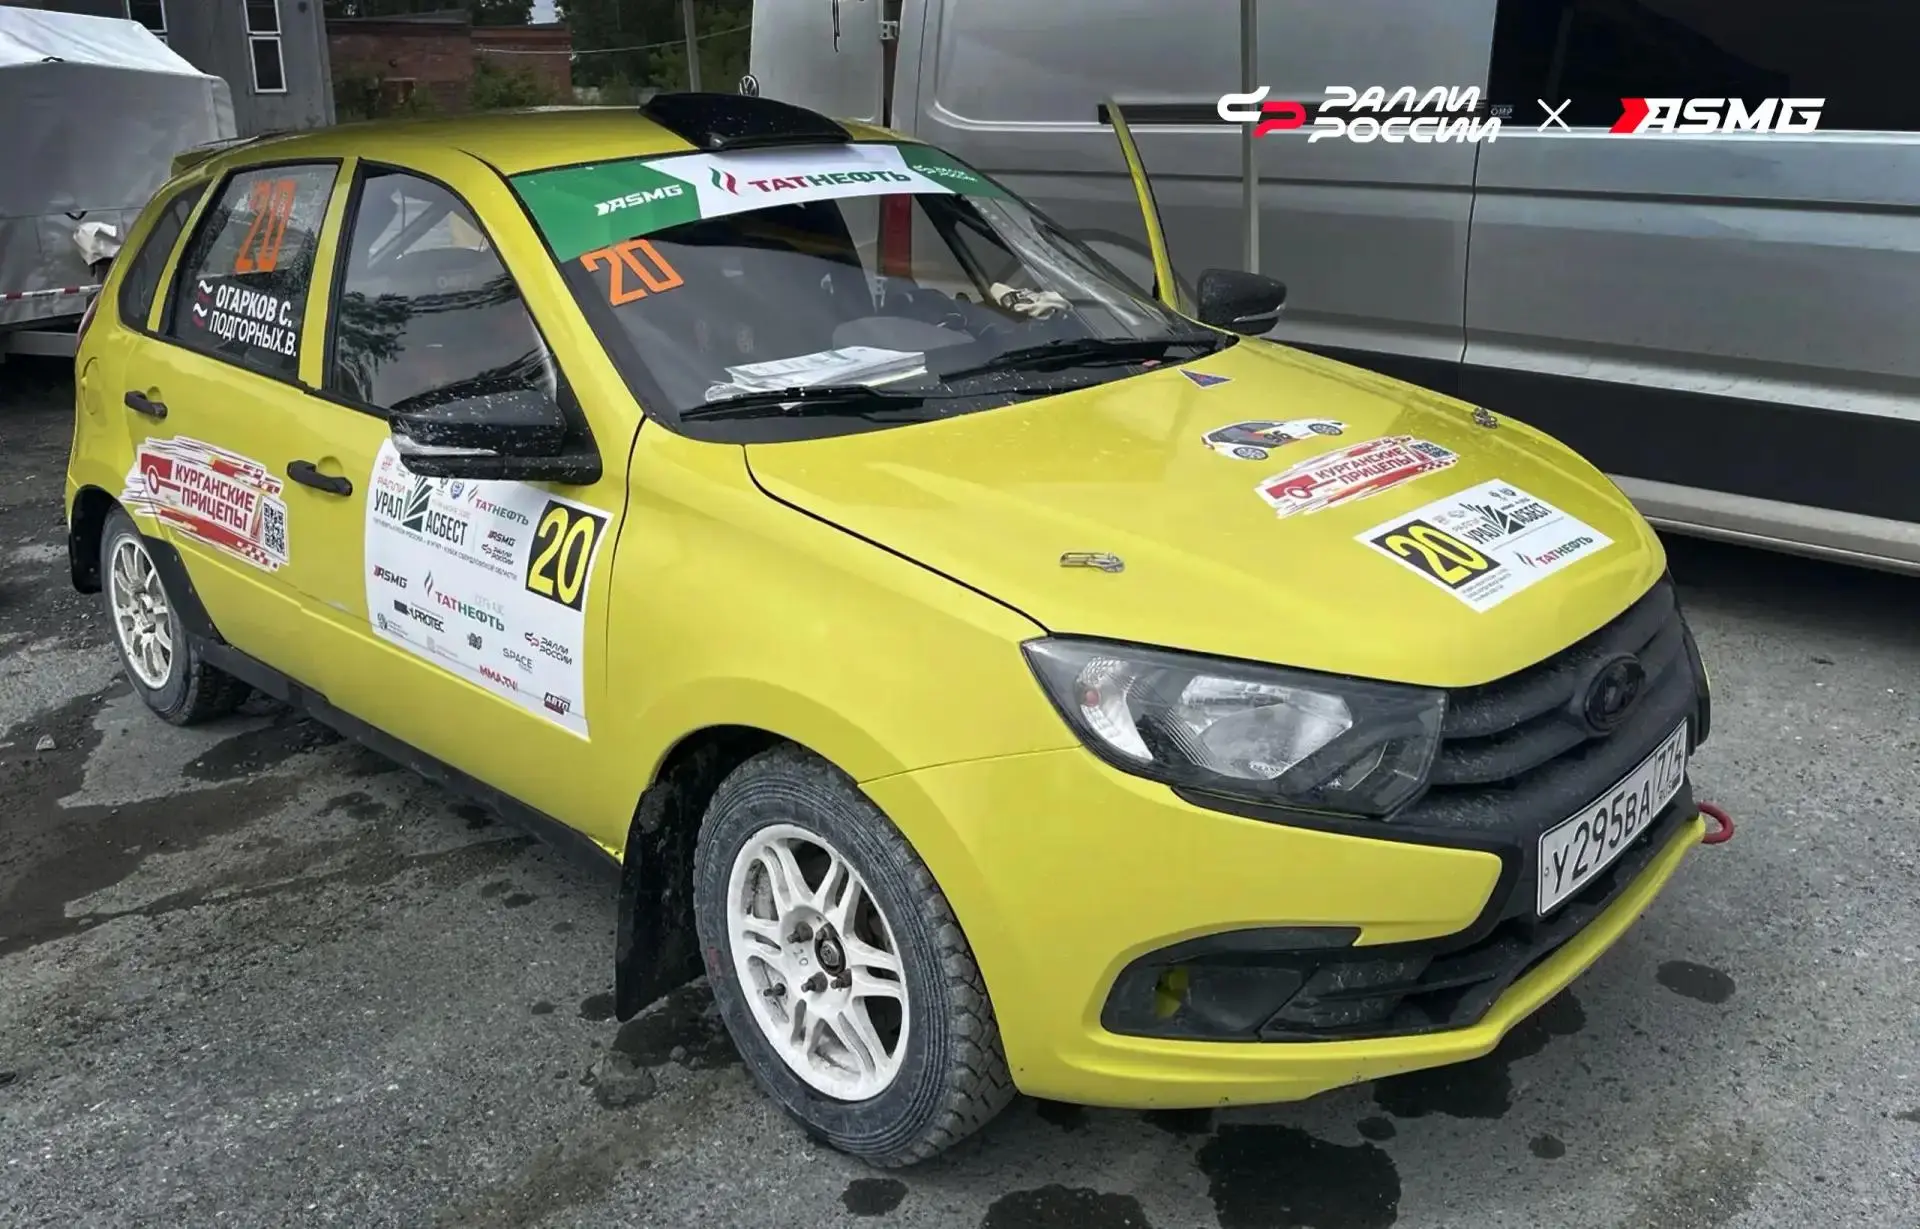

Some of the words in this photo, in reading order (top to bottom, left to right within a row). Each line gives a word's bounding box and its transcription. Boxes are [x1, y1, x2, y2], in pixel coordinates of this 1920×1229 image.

[748, 170, 911, 192] ТАТНЕФТЬ
[606, 184, 684, 213] ASMG
[235, 180, 297, 274] 20
[580, 239, 684, 306] 20
[215, 284, 277, 322] ОГАРКОВ
[279, 301, 292, 327] С.
[1315, 447, 1406, 479] КУРГАНСКИЕ
[1337, 456, 1415, 484] ПРИЦЕПЫ
[175, 463, 256, 513] КУРГАНСКИЕ
[374, 488, 403, 520] УРАЛ
[181, 485, 248, 531] ПРИЦЕПЫ
[475, 499, 529, 525] ТАТНЕФТЬ
[425, 510, 468, 546] АСБЕСТ
[1462, 523, 1501, 544] УРАЛ
[528, 507, 595, 604] 20
[1385, 523, 1489, 584] 20
[1535, 535, 1594, 565] ТАТНЕФТЬ
[376, 566, 407, 589] ASMG
[434, 590, 505, 631] ТАТНЕФТЬ
[540, 645, 572, 665] РОССИИ
[541, 637, 569, 655] РАЛЛИ
